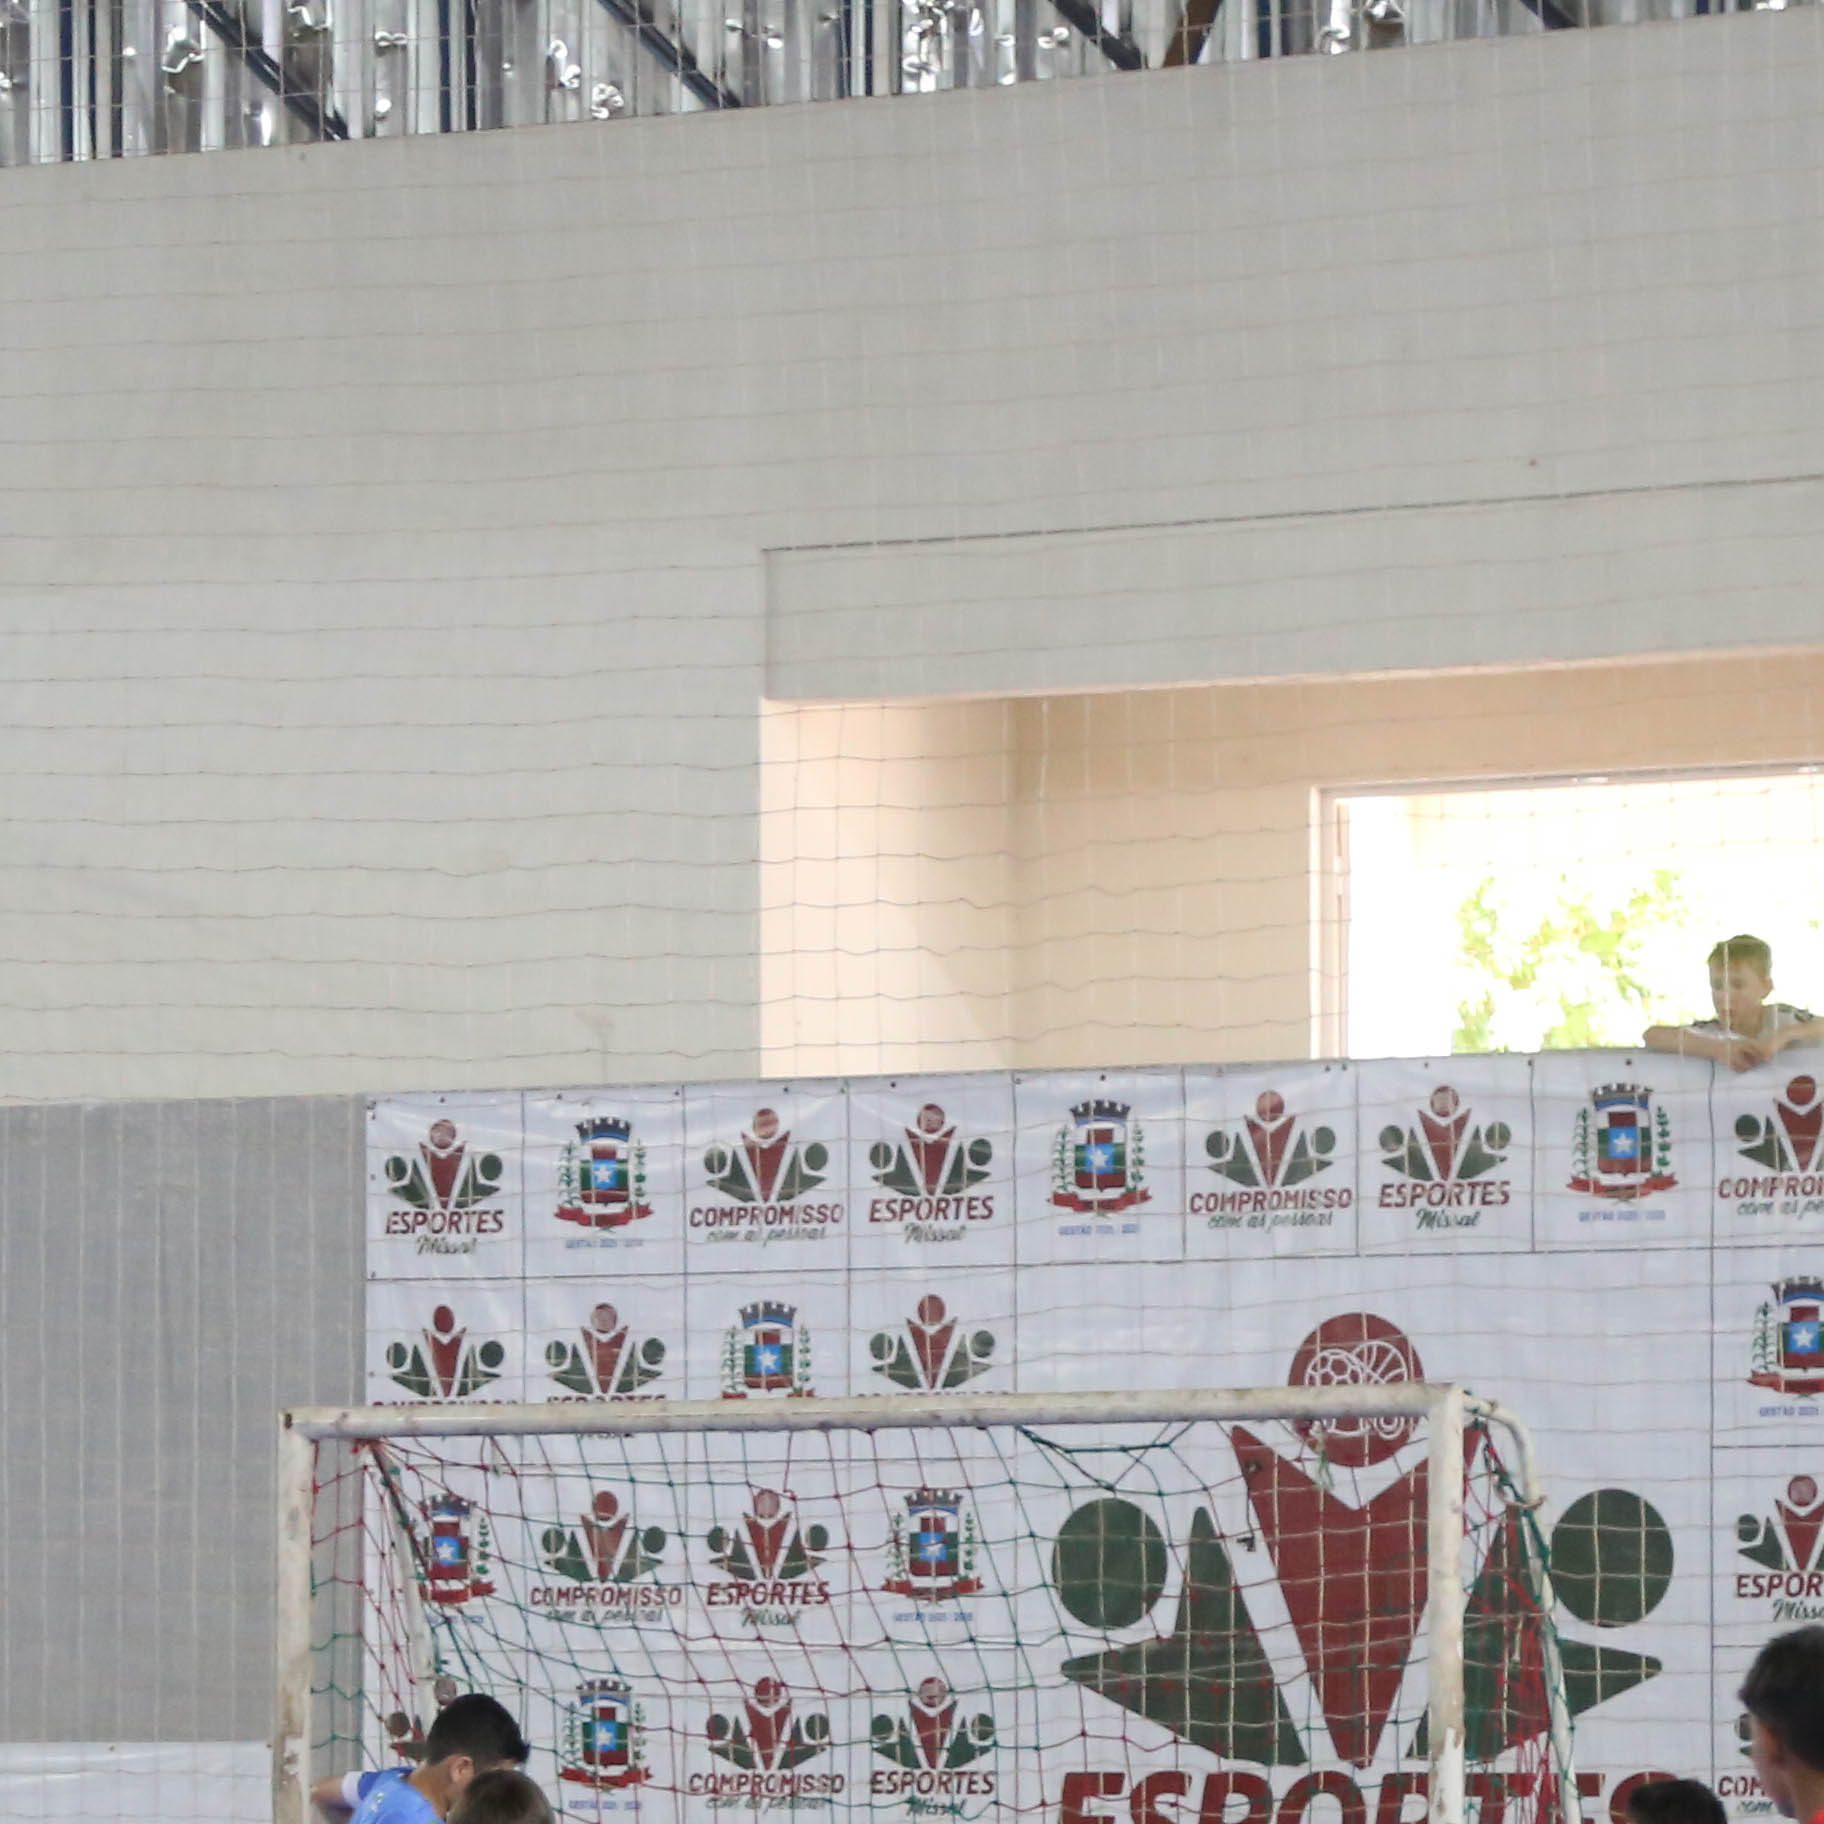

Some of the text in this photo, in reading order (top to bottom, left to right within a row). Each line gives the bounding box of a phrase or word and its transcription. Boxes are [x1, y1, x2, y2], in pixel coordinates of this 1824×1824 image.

[1189, 1188, 1352, 1214] COMPROMISSO
[1379, 1181, 1511, 1208] ESPORTES
[690, 1203, 844, 1227] COMPROMISSO
[869, 1196, 994, 1223] ESPORTES
[386, 1209, 504, 1236] ESPORTES
[530, 1584, 682, 1607] COMPROMISSO
[707, 1581, 829, 1606] ESPORTES
[689, 1772, 845, 1794] COMPROMISSO
[871, 1770, 995, 1794] ESPORTES
